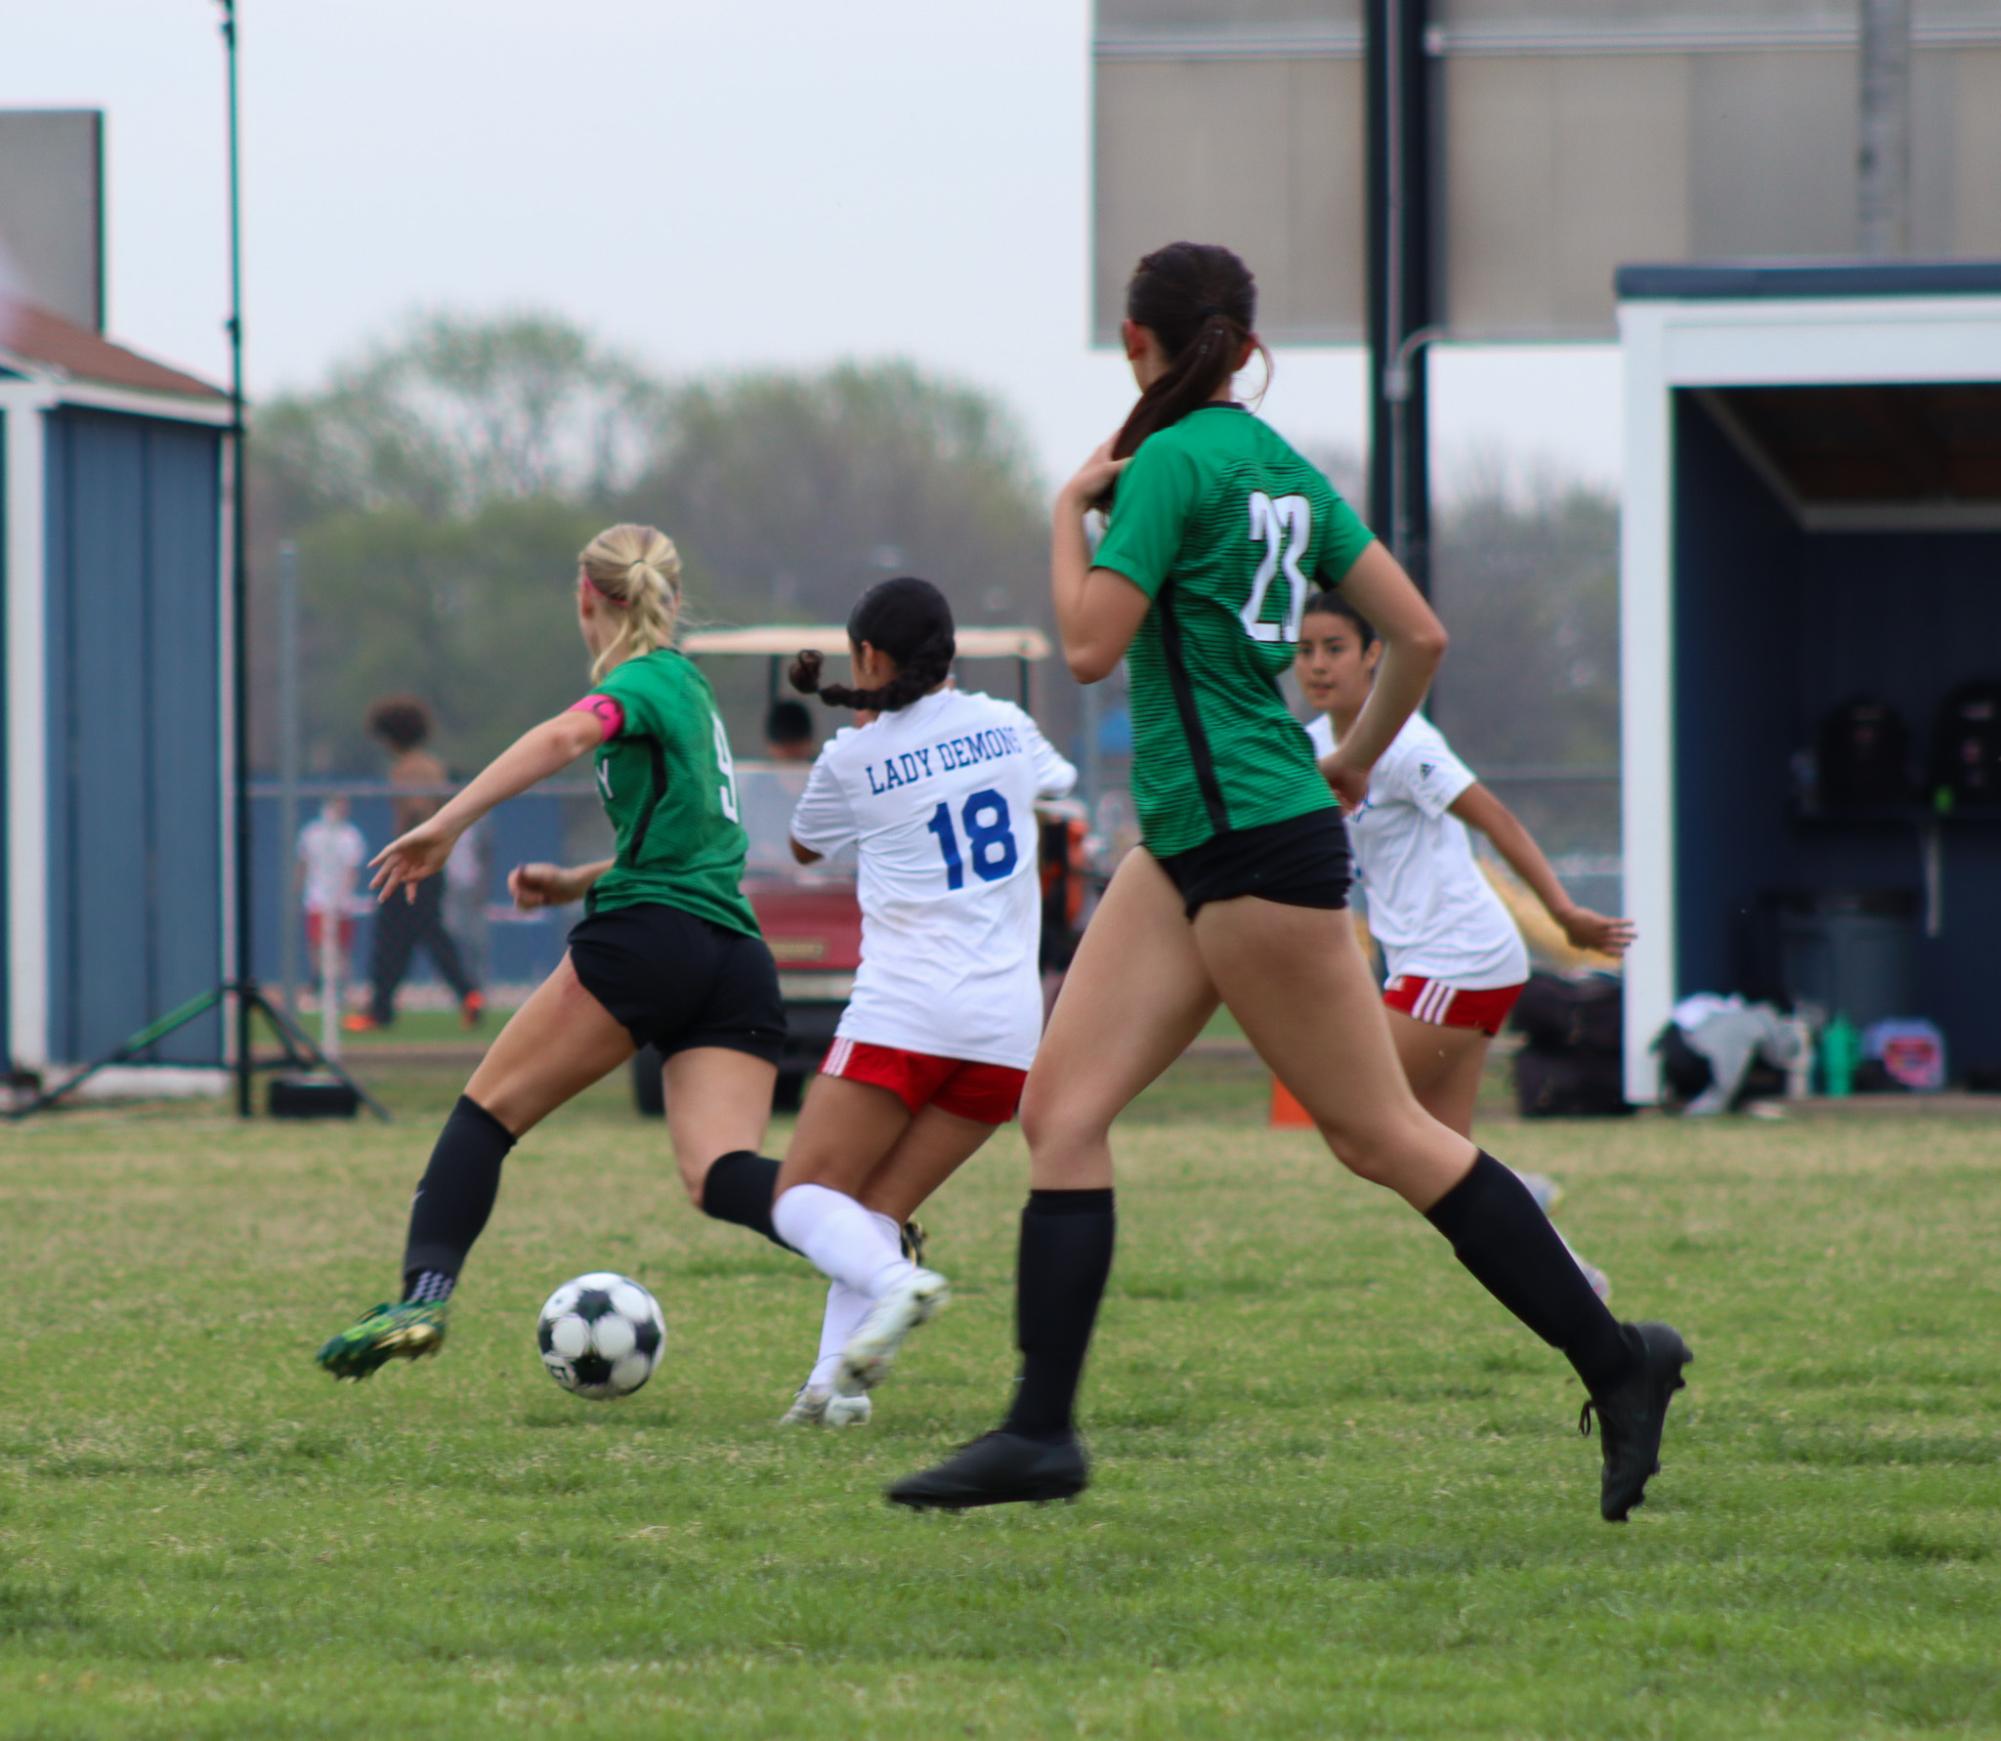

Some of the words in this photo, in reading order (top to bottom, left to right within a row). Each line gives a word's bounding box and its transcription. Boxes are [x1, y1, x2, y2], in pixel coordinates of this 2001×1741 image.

[1239, 491, 1311, 642] 23
[711, 711, 739, 824] 9
[865, 748, 933, 796] LADY
[928, 789, 1018, 890] 18
